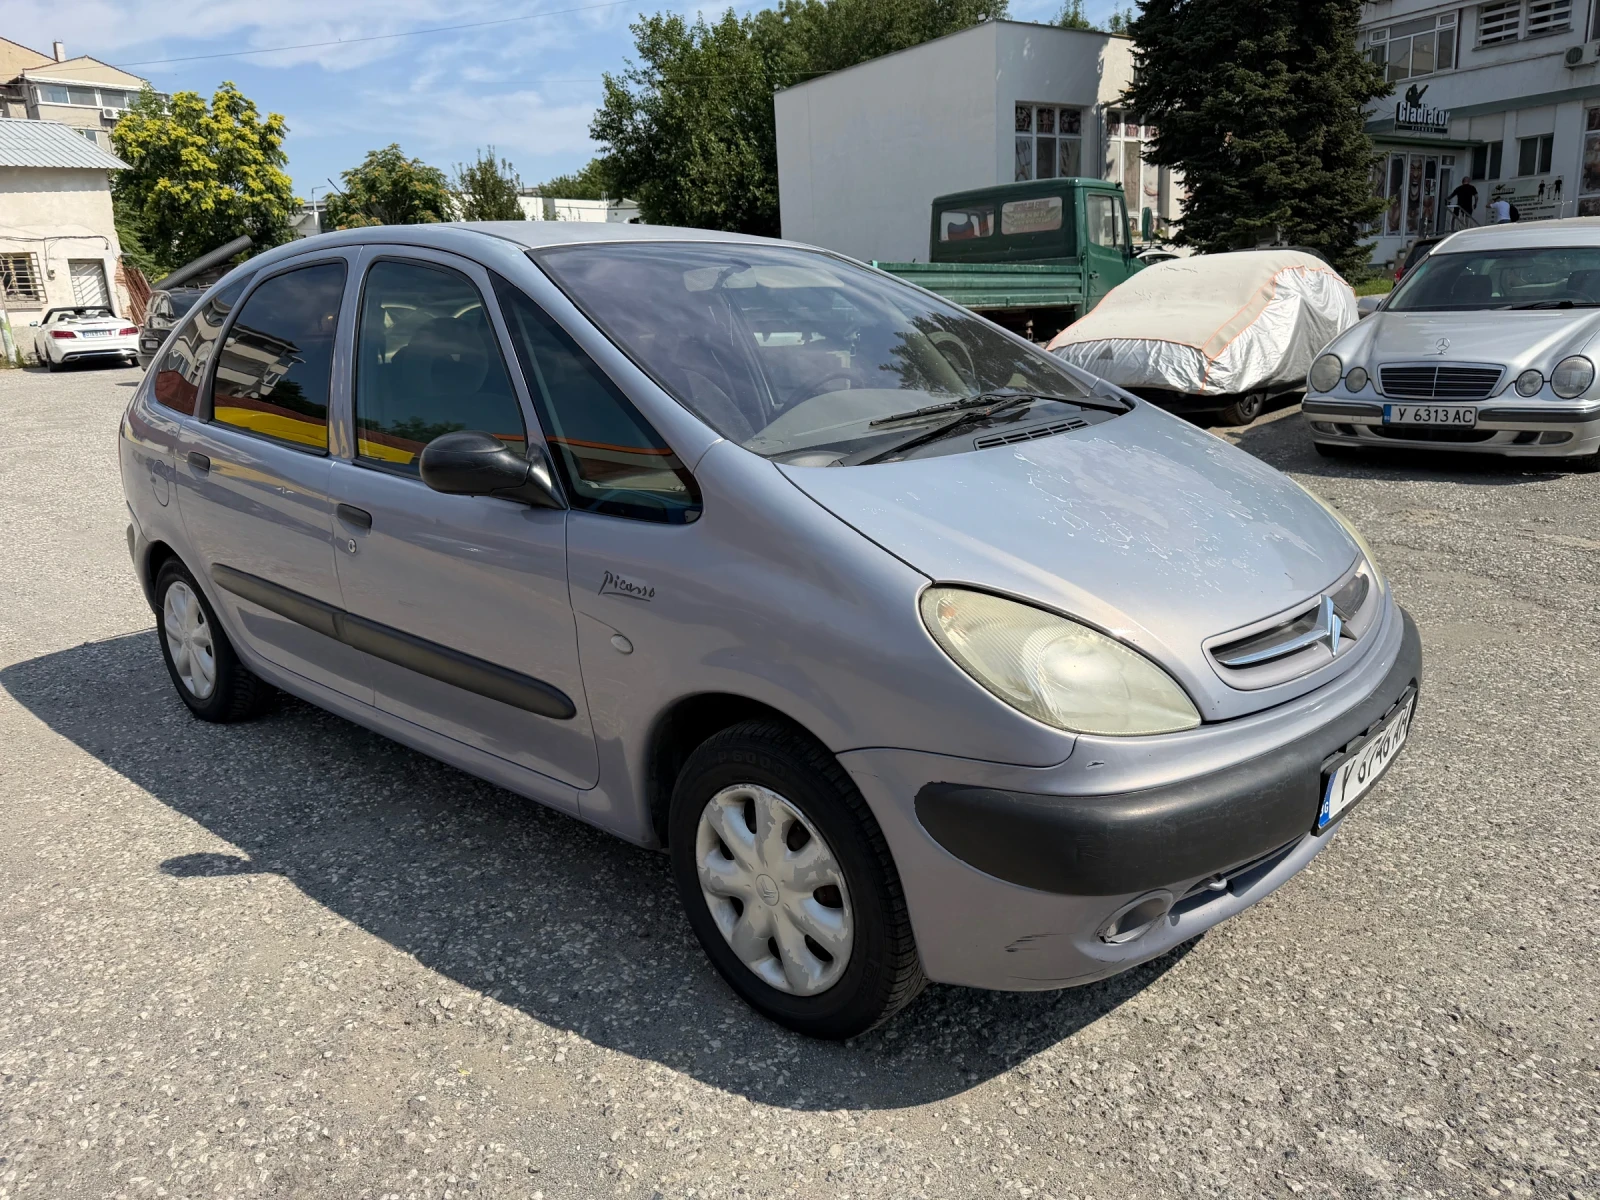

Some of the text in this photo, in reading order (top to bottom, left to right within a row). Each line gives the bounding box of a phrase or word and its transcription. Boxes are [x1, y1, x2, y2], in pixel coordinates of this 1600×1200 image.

[1398, 102, 1450, 125] Gladiator
[1413, 408, 1449, 422] 6313
[1452, 409, 1473, 423] AC
[598, 570, 655, 600] Picasso
